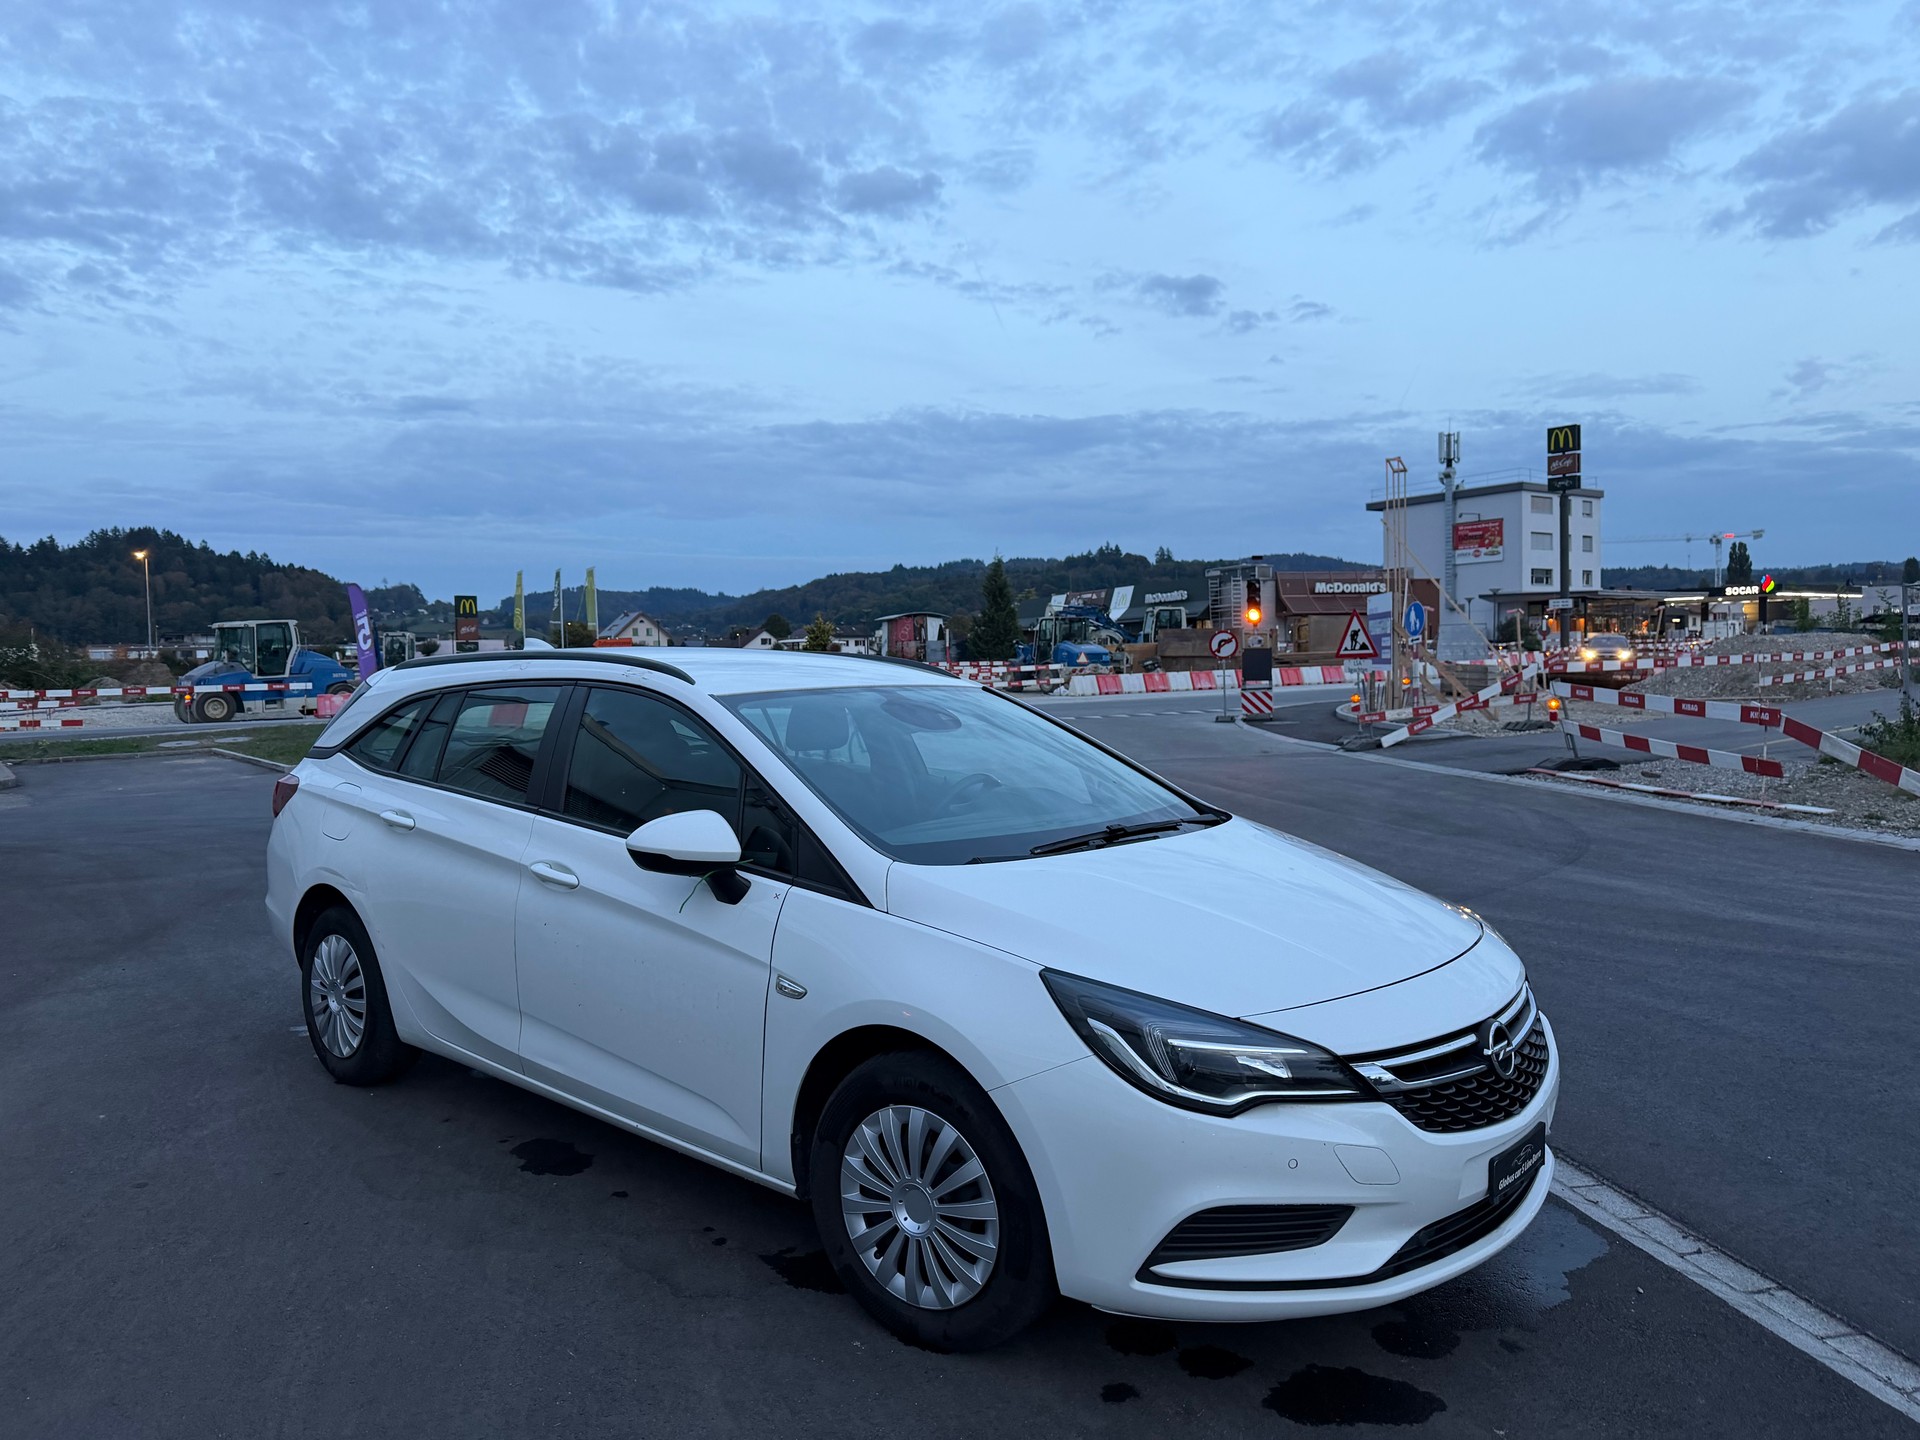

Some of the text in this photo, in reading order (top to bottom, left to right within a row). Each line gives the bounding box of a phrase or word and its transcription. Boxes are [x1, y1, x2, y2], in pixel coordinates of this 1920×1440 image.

[1315, 581, 1387, 594] McDonald's
[1725, 585, 1760, 596] SOCAR
[1576, 689, 1589, 697] KIBAG
[1624, 696, 1639, 704] KIBAG
[1682, 703, 1698, 712] KIBAG
